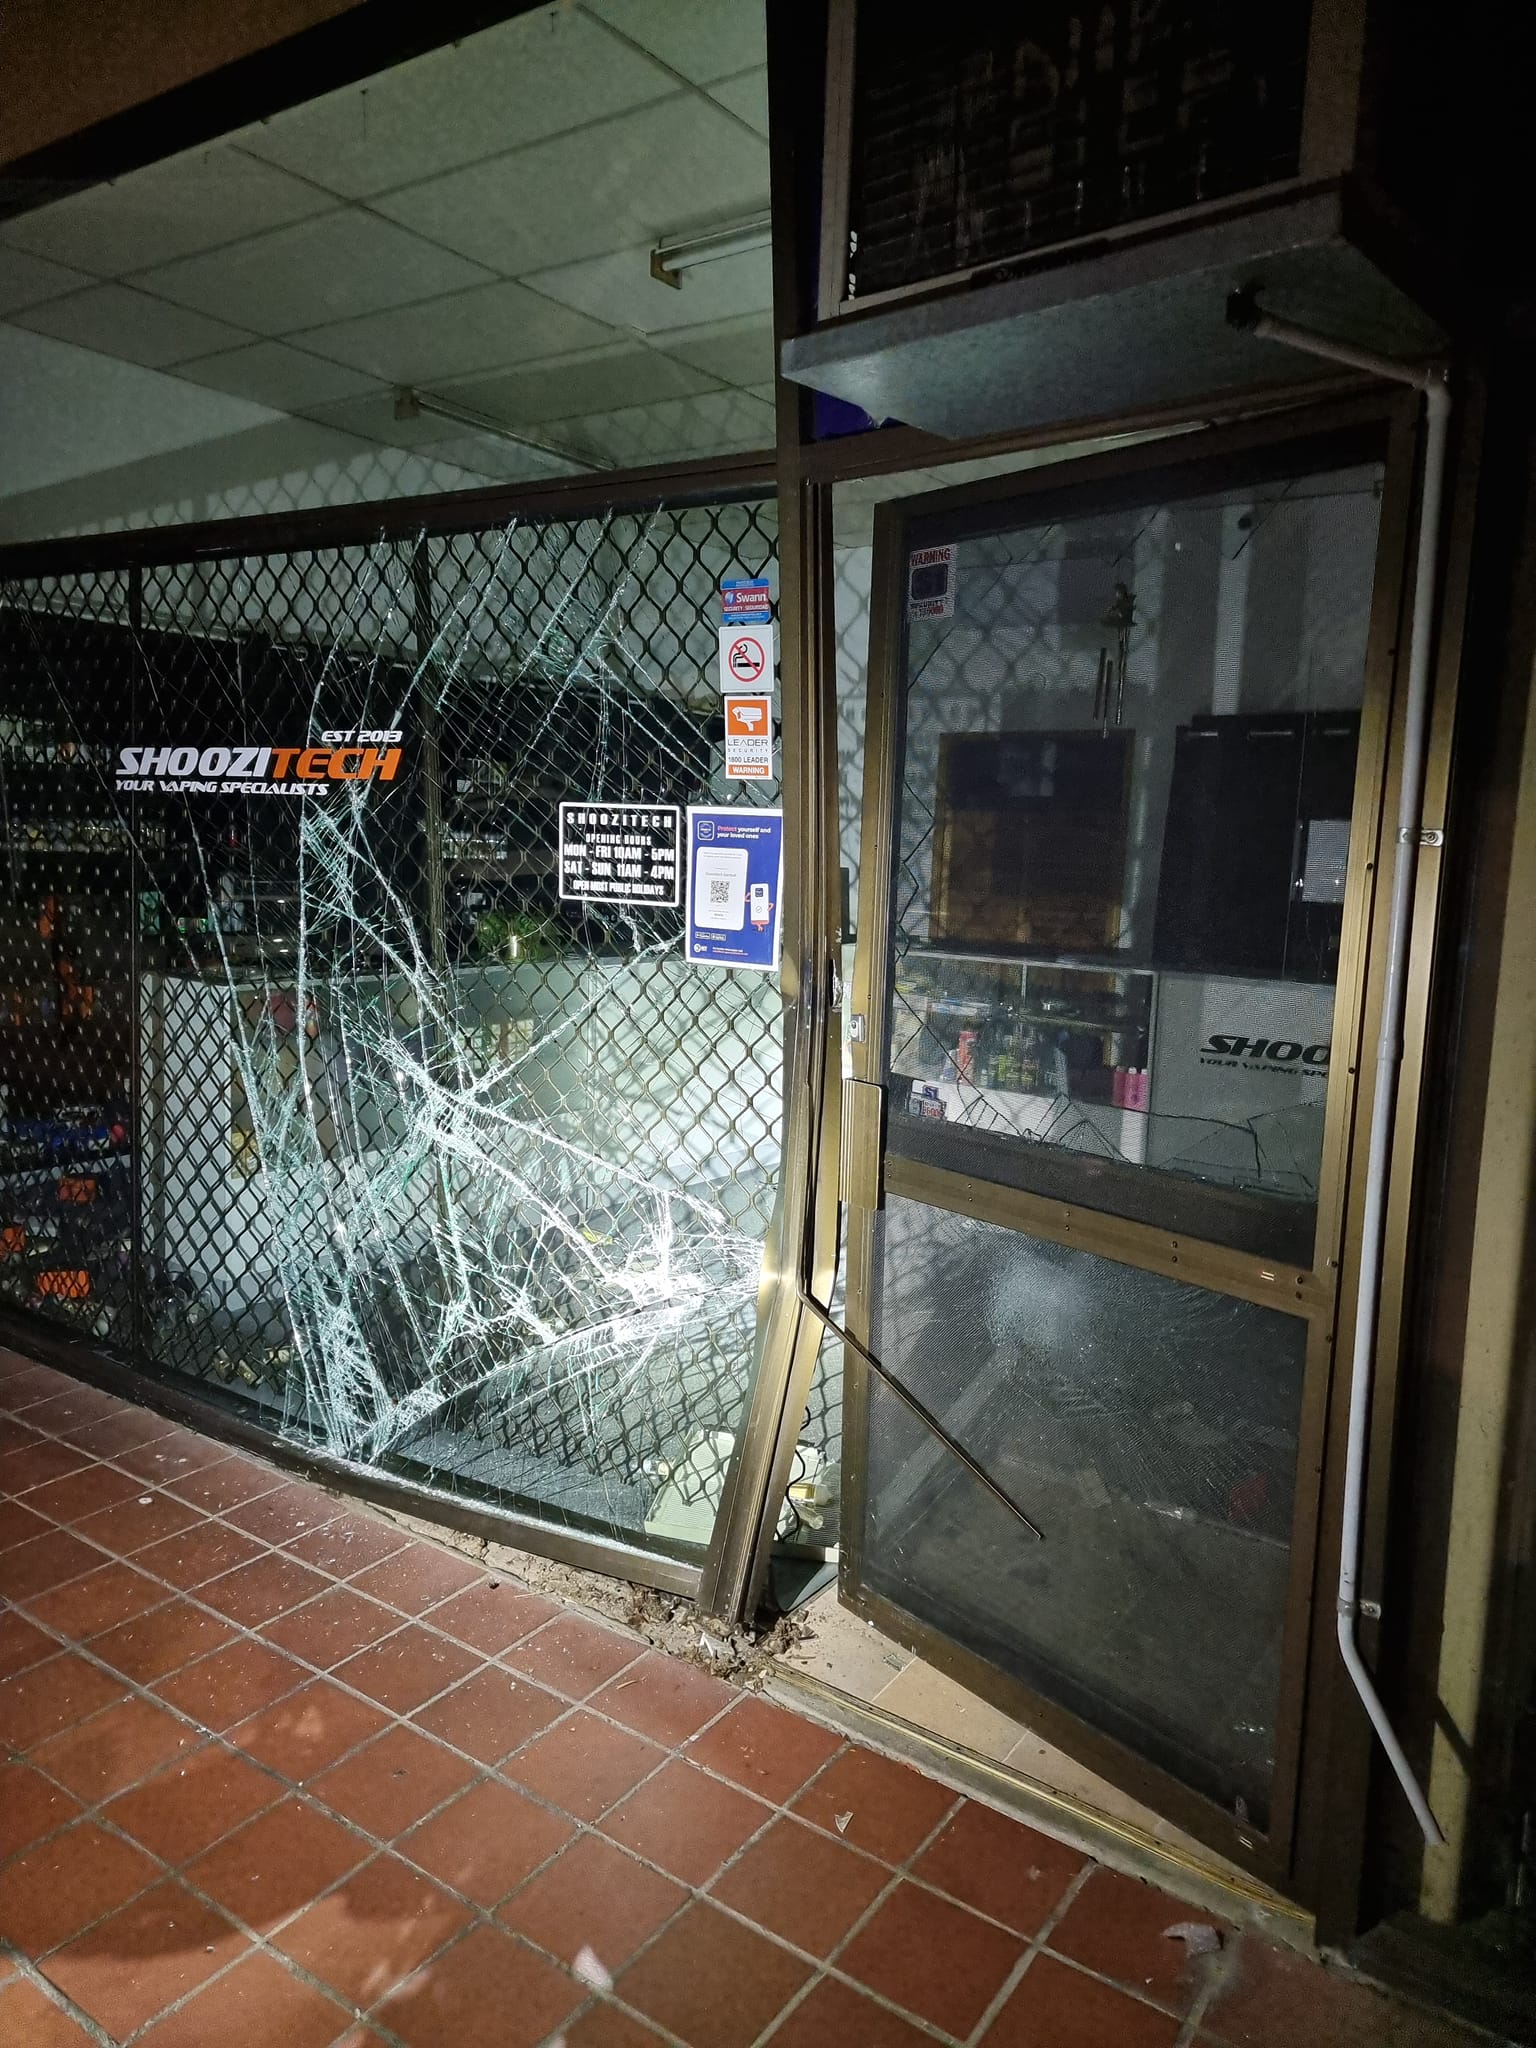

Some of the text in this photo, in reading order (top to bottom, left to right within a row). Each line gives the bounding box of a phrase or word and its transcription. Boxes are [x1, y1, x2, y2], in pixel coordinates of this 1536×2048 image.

[911, 547, 951, 567] WARNING
[736, 592, 767, 603] Swann
[321, 730, 403, 743] EST 2013
[727, 738, 769, 747] LEADER
[115, 747, 402, 781] SHOOZITECH
[732, 766, 766, 775] WARNING
[115, 780, 329, 796] YOUR VAPING SPECIALISTS
[566, 812, 672, 828] SHOOZITECH
[585, 833, 652, 846] OPENING HOURS
[564, 843, 586, 857] MON
[596, 845, 611, 858] FRI
[614, 846, 642, 860] 10AM
[651, 848, 674, 861] 5PM
[564, 860, 583, 874] SAT
[591, 861, 611, 876] SUN
[617, 863, 642, 878] 11AM
[650, 865, 674, 880] 4PM
[573, 879, 664, 895] OPEN MOST PUBLIC HOLIDAYS
[1200, 1057, 1238, 1067] YOUR
